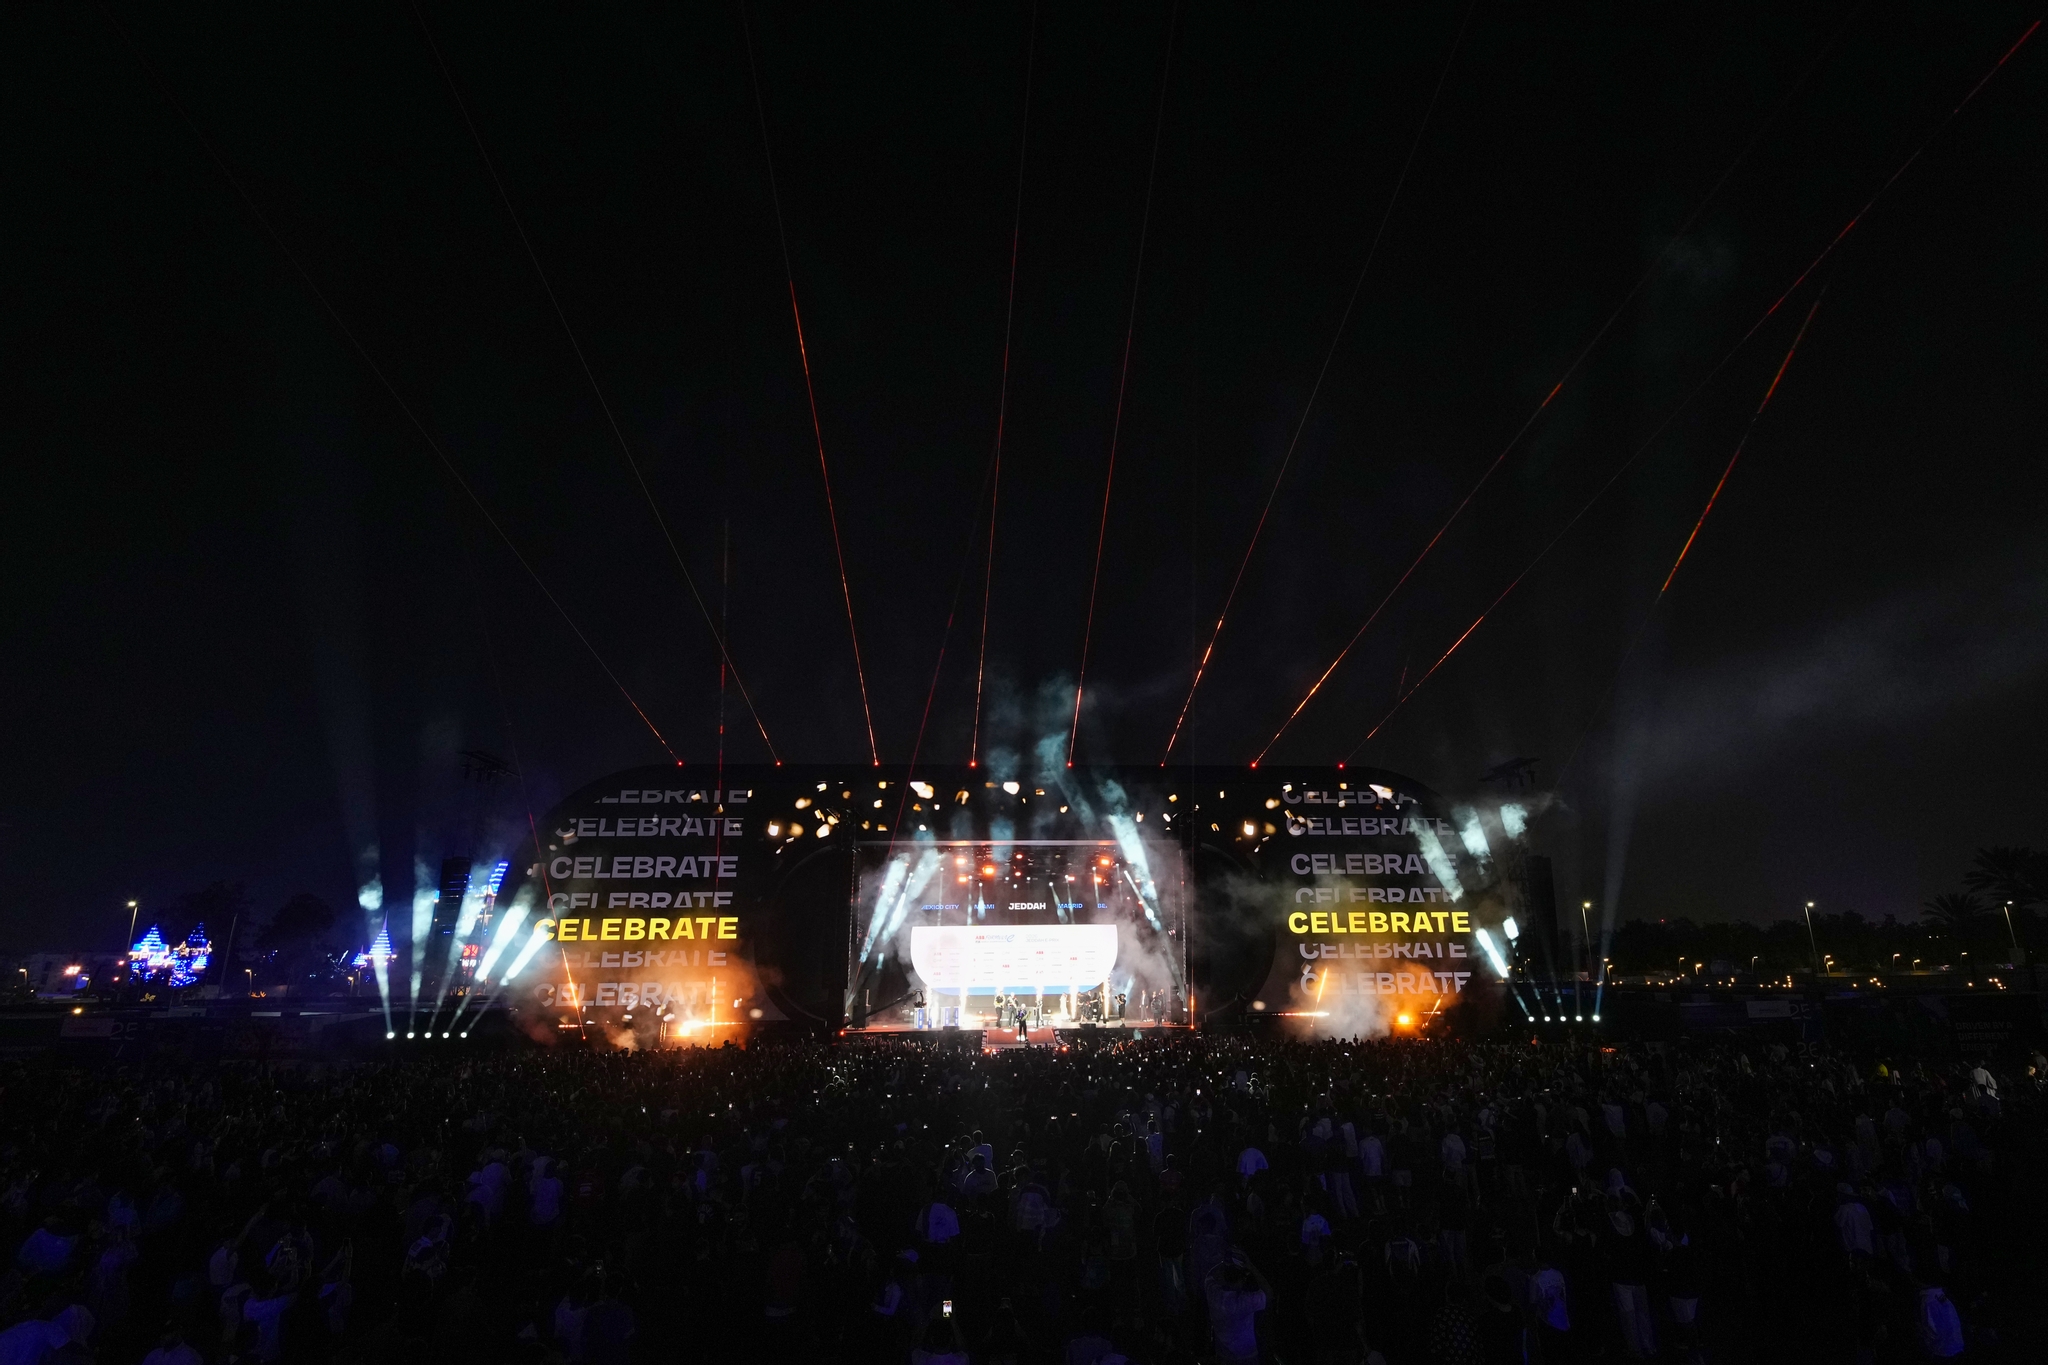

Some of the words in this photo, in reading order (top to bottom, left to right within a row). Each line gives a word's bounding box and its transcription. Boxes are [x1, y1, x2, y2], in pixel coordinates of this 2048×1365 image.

[555, 817, 744, 837] CELEBRATE
[550, 855, 739, 879] CELEBRATE
[1008, 902, 1046, 910] JEDDAH
[533, 917, 739, 941] CELEBRATE
[1288, 911, 1471, 934] CELEBRATE
[533, 980, 727, 1007] CELEBRATE
[1300, 971, 1471, 995] CELEBRATE
